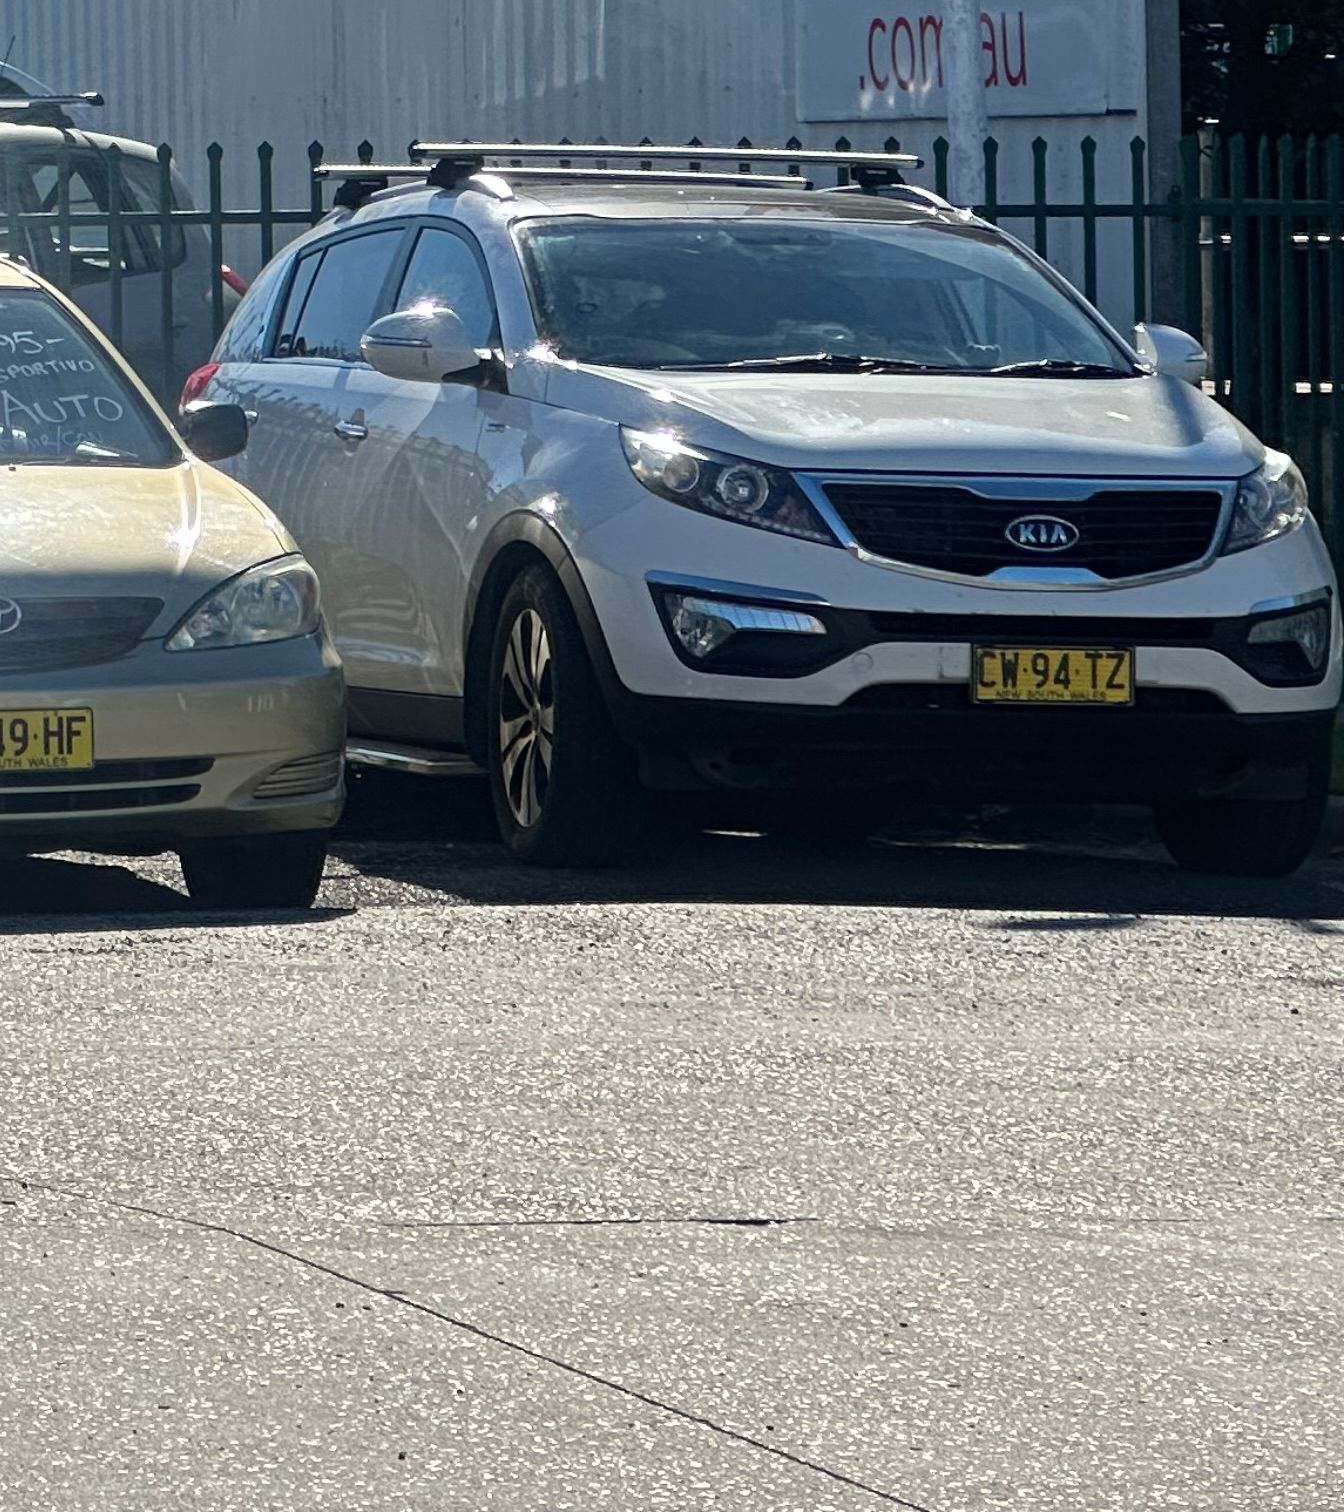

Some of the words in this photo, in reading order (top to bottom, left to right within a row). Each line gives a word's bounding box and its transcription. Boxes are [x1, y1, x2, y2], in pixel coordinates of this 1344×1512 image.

[0, 389, 124, 427] AUTO
[1019, 523, 1068, 544] KIA
[29, 757, 68, 768] WALES
